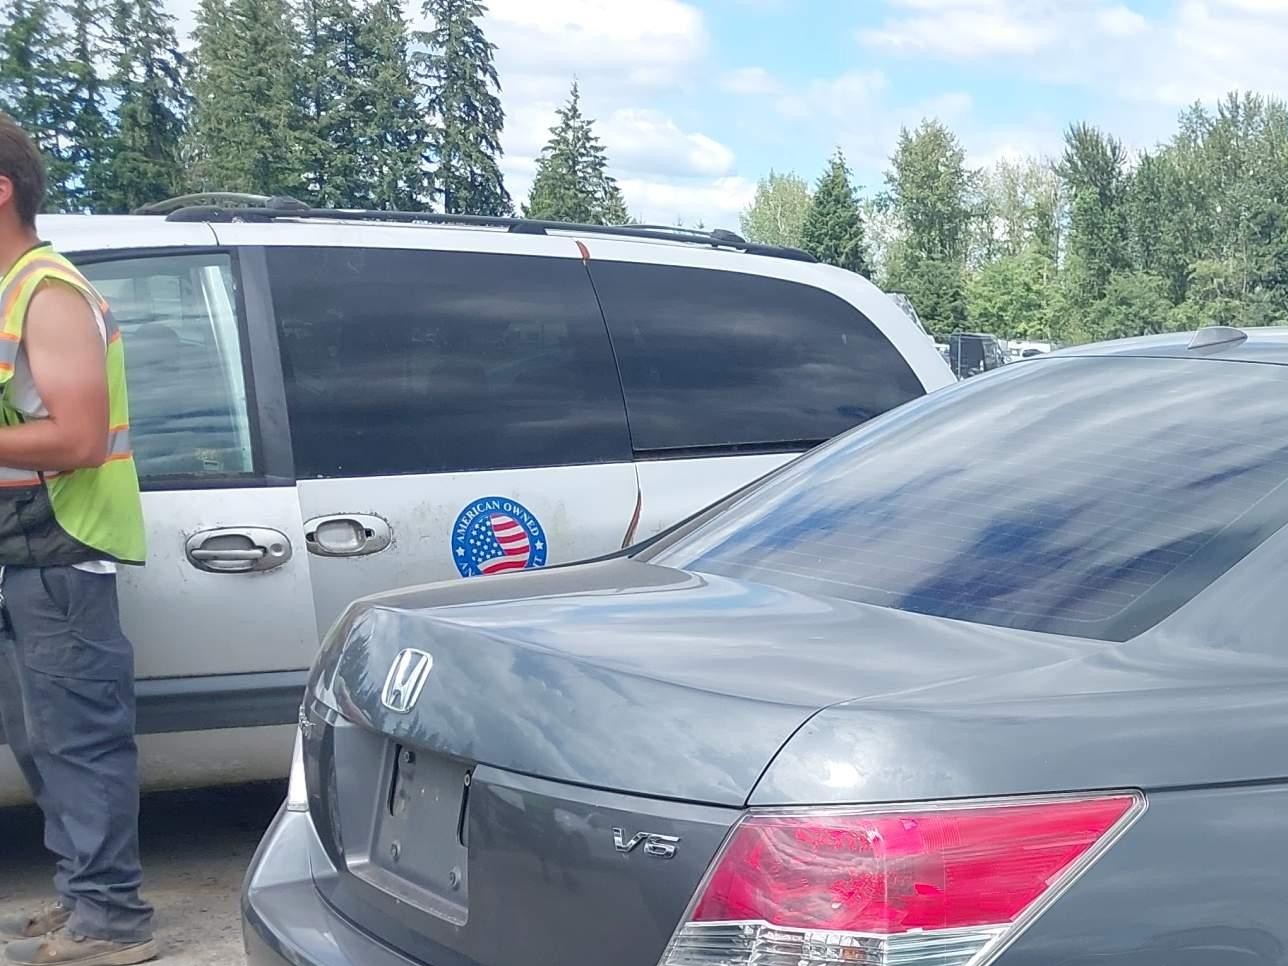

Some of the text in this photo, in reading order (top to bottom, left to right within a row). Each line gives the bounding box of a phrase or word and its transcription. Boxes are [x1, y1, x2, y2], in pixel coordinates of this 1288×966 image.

[457, 500, 539, 543] AMERICAN OWNED
[612, 827, 681, 859] V6
